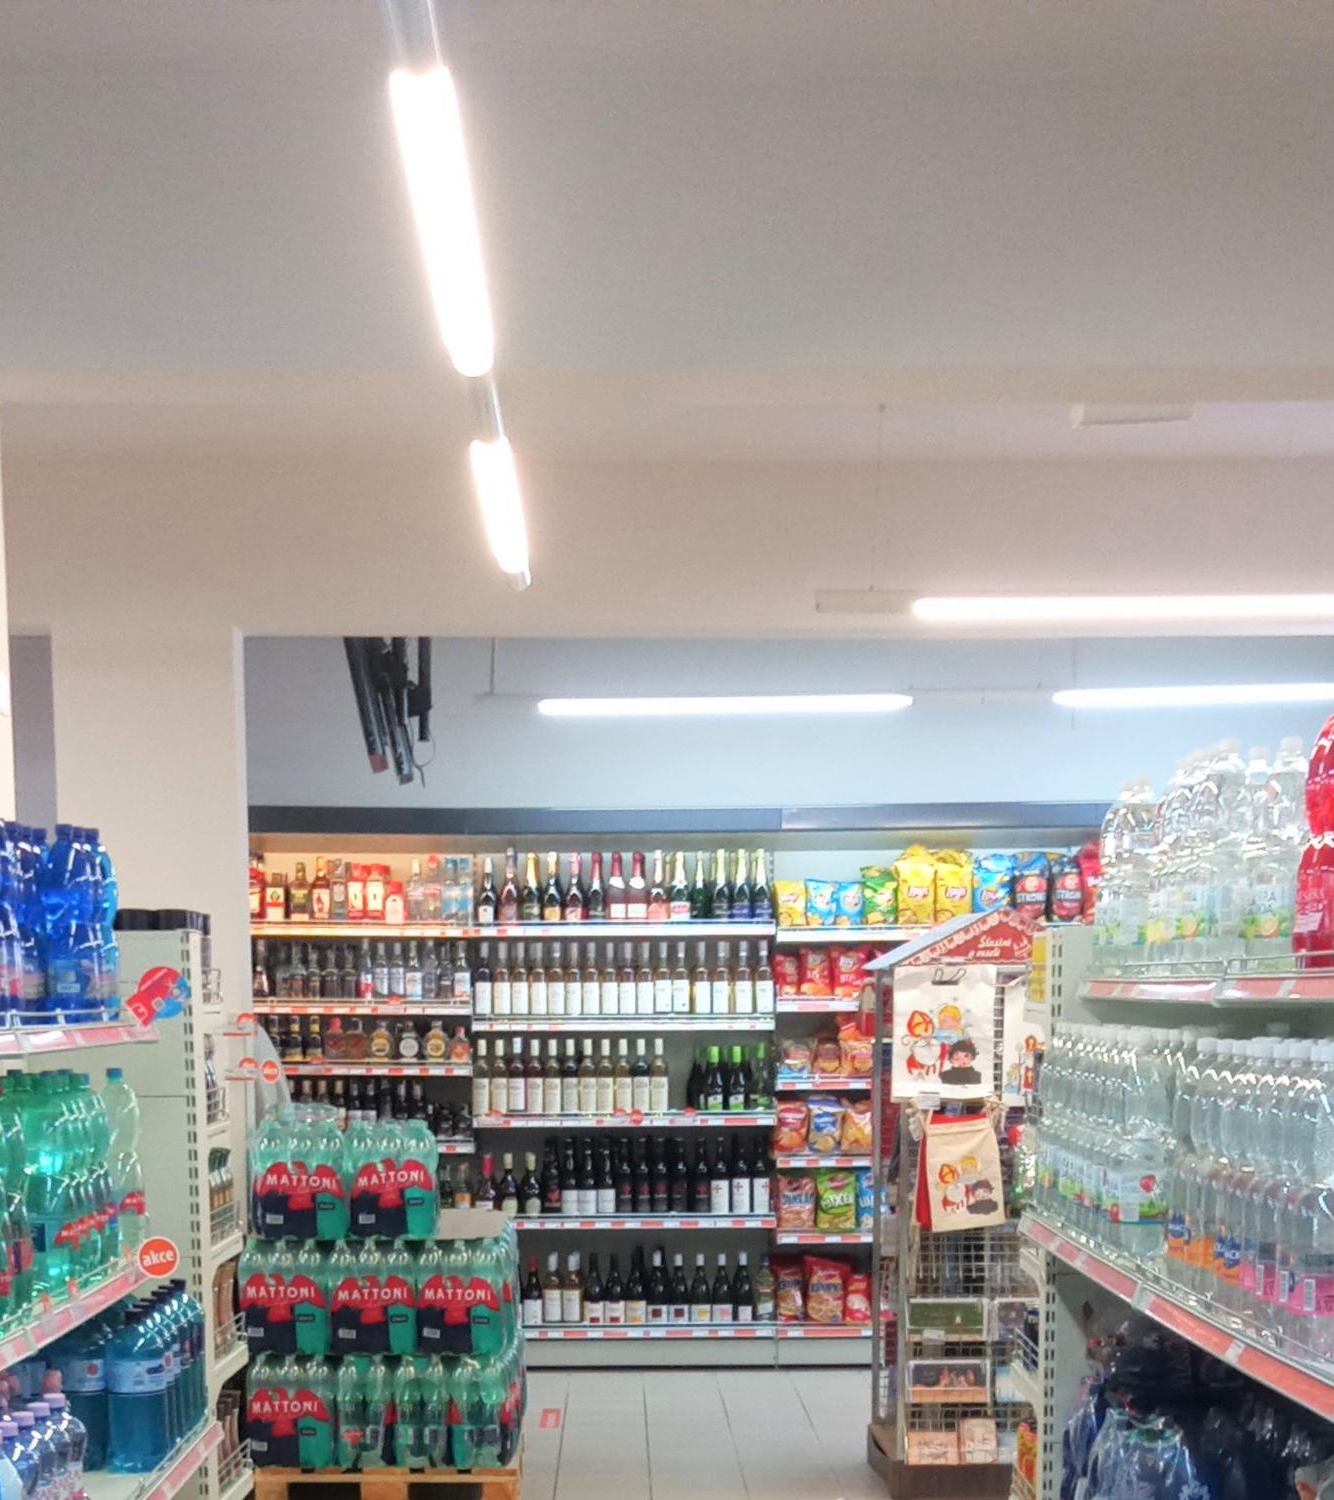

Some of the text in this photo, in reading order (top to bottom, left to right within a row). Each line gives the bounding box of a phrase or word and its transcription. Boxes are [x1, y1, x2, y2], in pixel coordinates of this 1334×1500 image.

[266, 1170, 338, 1190] MATTONI
[357, 1168, 425, 1188] MATTONI
[140, 1247, 177, 1270] akce
[246, 1284, 316, 1300] MATTONI
[336, 1285, 408, 1301] MATTONI
[424, 1284, 492, 1301] MATTONI
[251, 1398, 319, 1415] MATTONI
